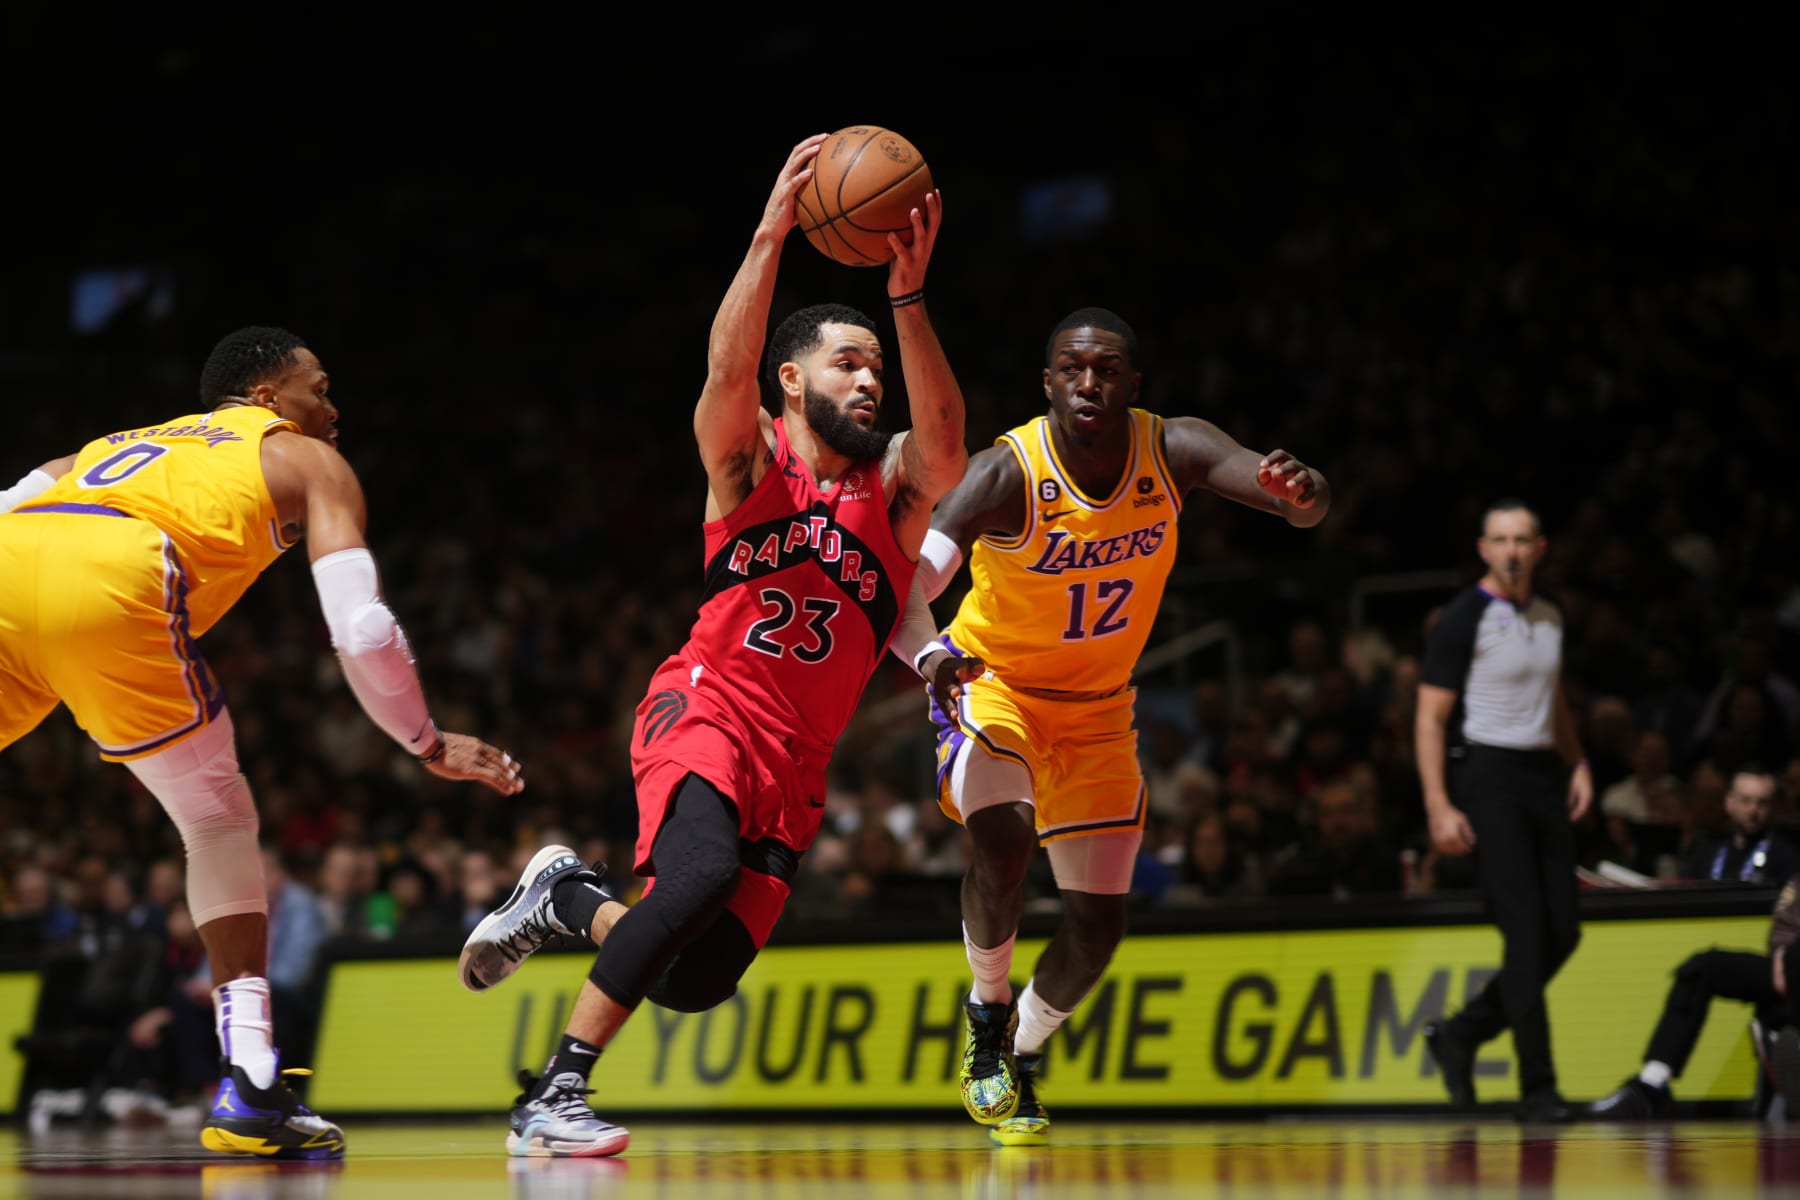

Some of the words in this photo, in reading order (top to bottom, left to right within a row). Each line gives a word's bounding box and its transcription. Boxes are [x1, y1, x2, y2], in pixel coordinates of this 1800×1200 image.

[76, 440, 170, 489] 0
[1042, 481, 1056, 500] 6
[1133, 494, 1165, 508] bibigo
[728, 516, 878, 601] RAPTORS
[1024, 520, 1168, 575] LAKERS
[743, 588, 841, 664] 23
[1061, 578, 1134, 643] 12
[650, 982, 876, 1086] YOUR
[903, 975, 1183, 1083] HME
